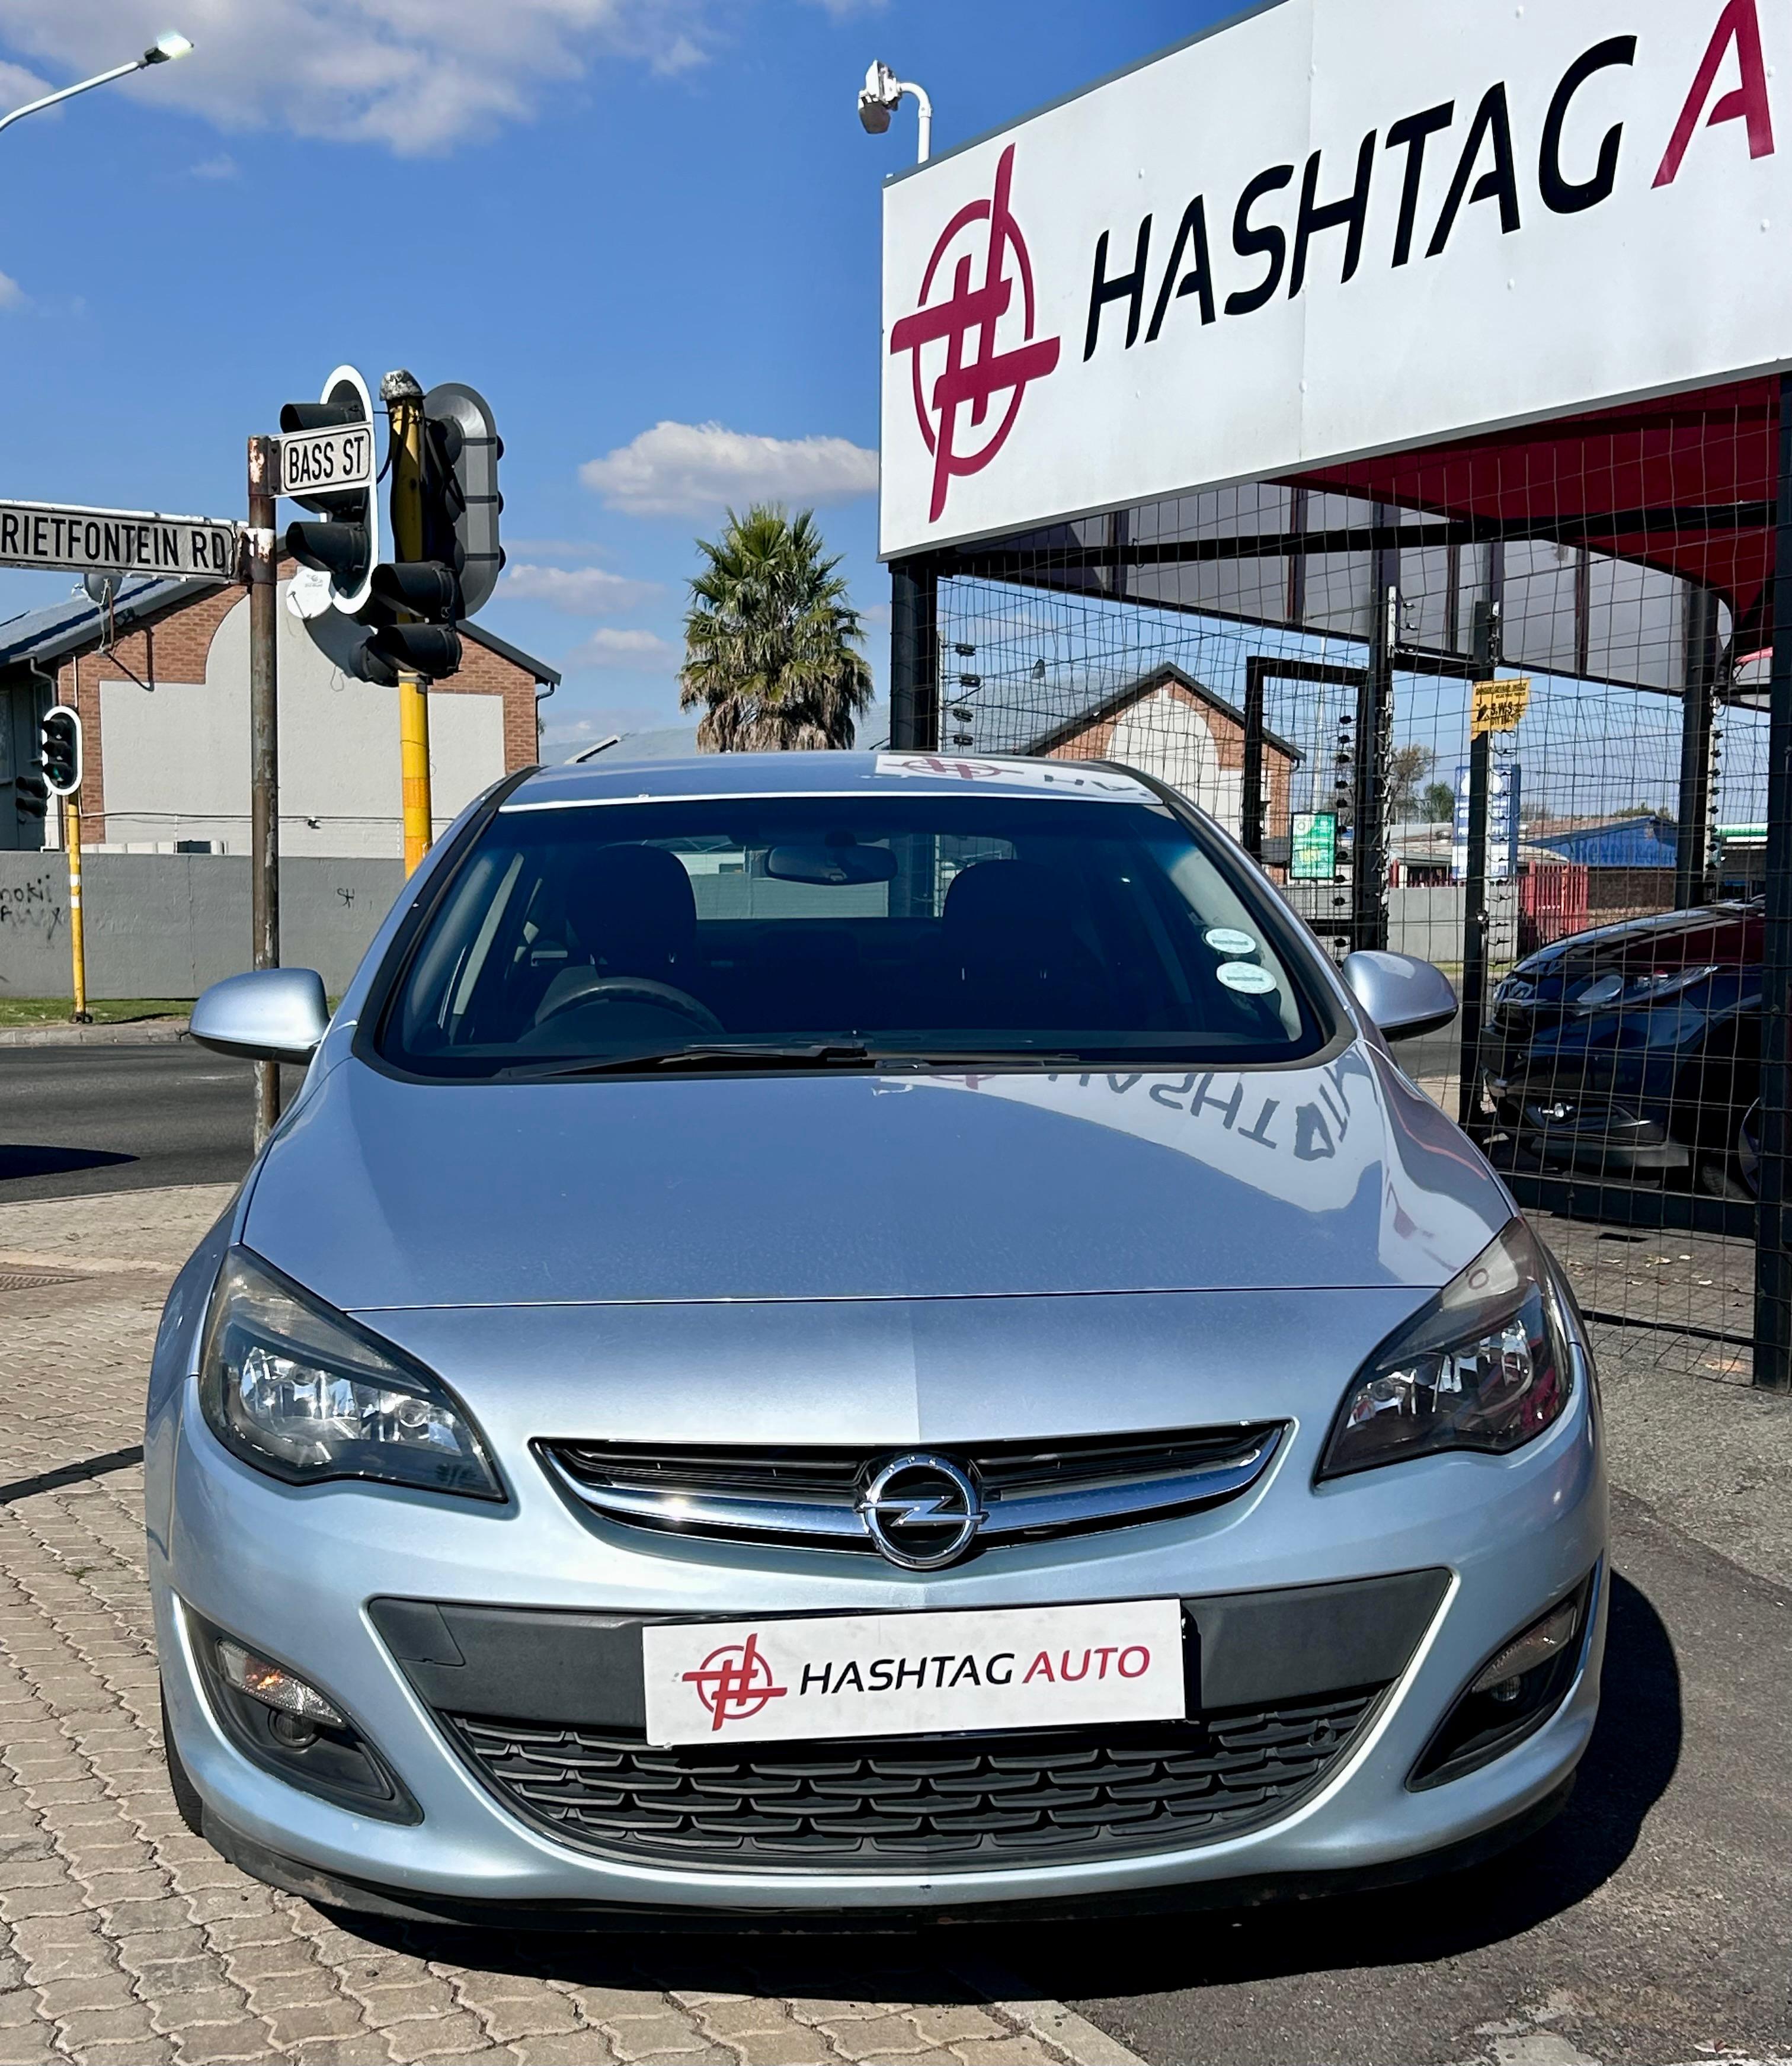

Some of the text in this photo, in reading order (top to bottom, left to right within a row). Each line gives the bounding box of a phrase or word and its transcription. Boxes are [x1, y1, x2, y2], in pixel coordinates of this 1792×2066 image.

[1083, 0, 1774, 363] HASHTAG A
[289, 436, 364, 483] BASS ST
[2, 513, 226, 569] RIETFONTEIN RD
[800, 1645, 1151, 1696] HASHTAG AUTO
